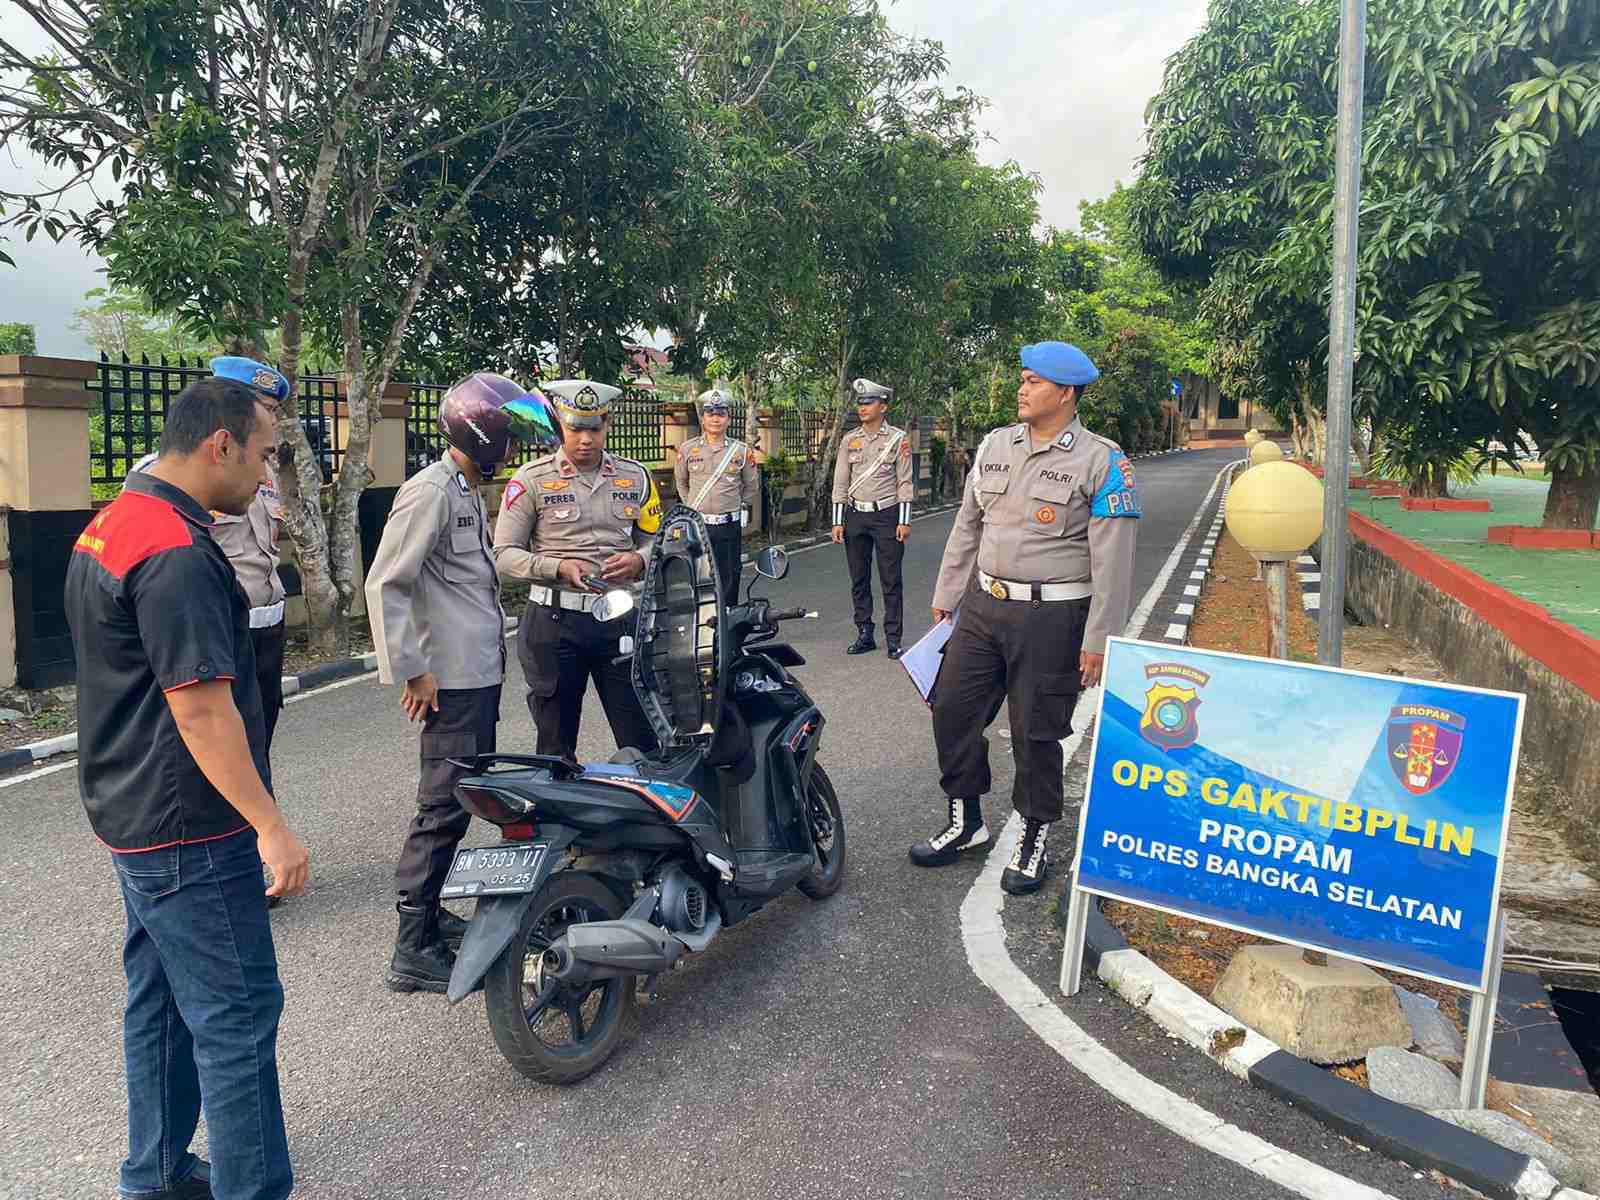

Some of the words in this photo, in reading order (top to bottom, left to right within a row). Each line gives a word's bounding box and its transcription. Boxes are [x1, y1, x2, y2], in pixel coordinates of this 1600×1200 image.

[1039, 470, 1072, 483] POLRI
[544, 494, 576, 504] PERES
[612, 491, 638, 501] POLRI
[1402, 706, 1450, 721] PROPAM
[1112, 759, 1189, 797] OPS
[1200, 777, 1474, 857] GAKTIBPLIN
[1199, 818, 1352, 875] PROPAM
[1102, 830, 1200, 868] POLRES
[1205, 853, 1320, 897] BANGKA
[1327, 881, 1463, 930] SELATAN
